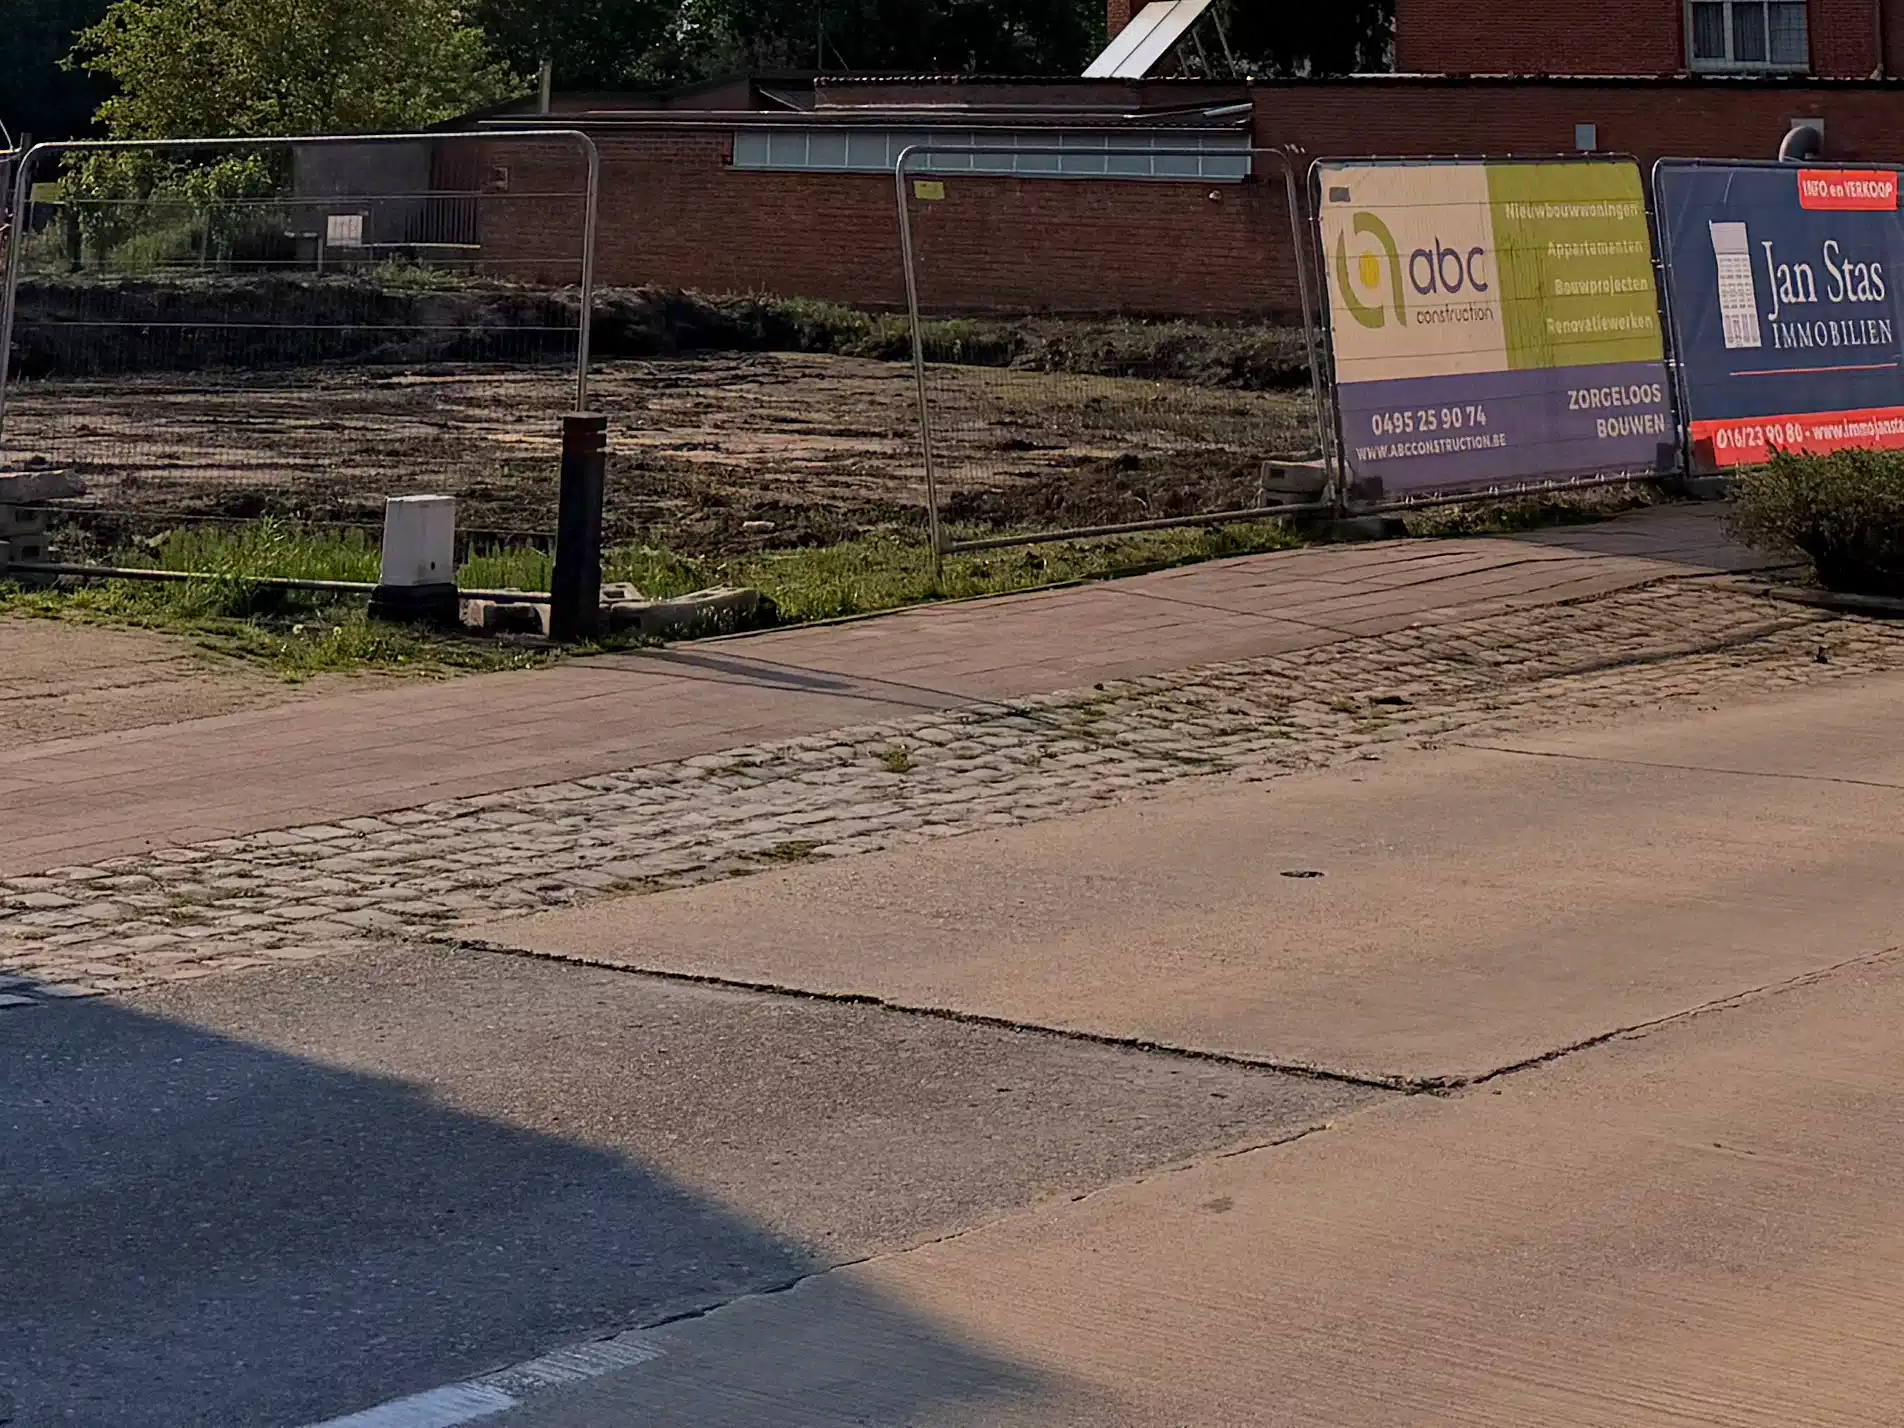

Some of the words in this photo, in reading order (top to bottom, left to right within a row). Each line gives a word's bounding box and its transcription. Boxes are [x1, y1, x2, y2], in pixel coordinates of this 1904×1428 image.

[1802, 180, 1828, 197] INFO
[1829, 185, 1844, 197] en
[1844, 180, 1894, 198] VERKOOP
[1505, 199, 1639, 220] Nieuwbouwwoningen
[1548, 240, 1644, 260] Appartementen
[1409, 236, 1489, 294] abc
[1554, 276, 1648, 296] Bouwprojecten
[1761, 240, 1818, 321] Jan
[1823, 239, 1885, 303] Stas
[1417, 301, 1494, 325] construction
[1546, 312, 1653, 335] Renovatiewerken
[1772, 319, 1893, 349] IMMOBILIEN
[1568, 383, 1662, 410] ZORGELOOS
[1372, 411, 1414, 436] 0495
[1417, 409, 1437, 432] 25
[1441, 407, 1462, 429] 90
[1466, 404, 1487, 427] 74
[1597, 414, 1665, 439] BOUWEN
[1355, 433, 1507, 461] WWW.ABCCONSTRUCTION.BE
[1716, 426, 1765, 449] 016/23
[1766, 424, 1784, 445] 90
[1786, 422, 1803, 443] 80
